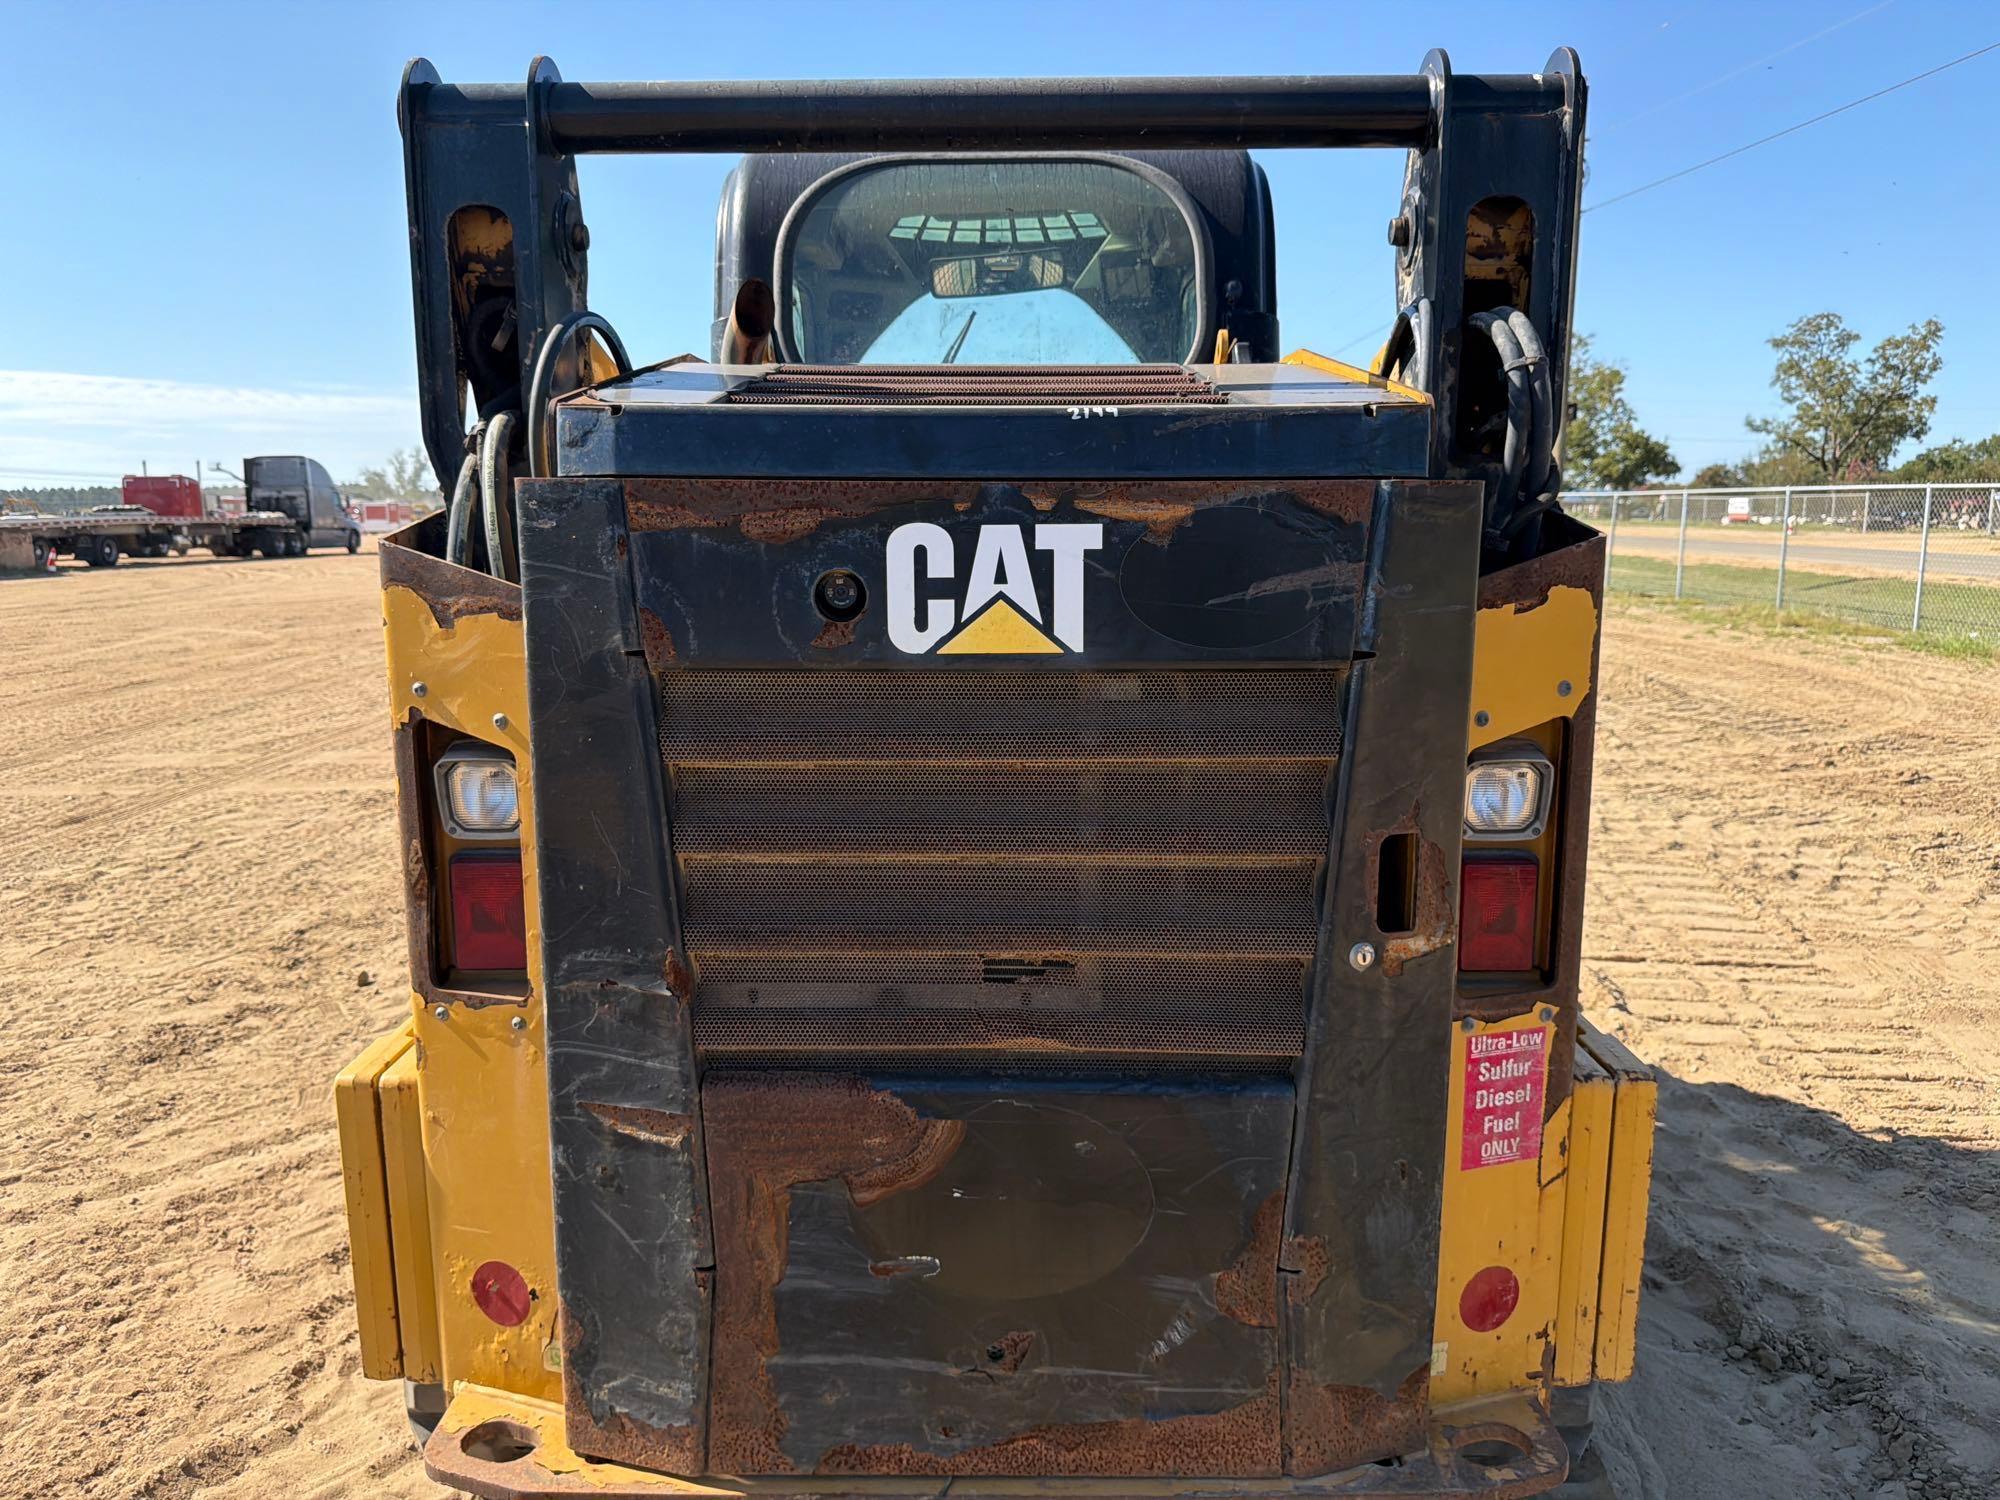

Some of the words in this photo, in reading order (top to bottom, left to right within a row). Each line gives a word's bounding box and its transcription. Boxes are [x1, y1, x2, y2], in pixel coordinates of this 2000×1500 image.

[886, 522, 1103, 654] CAT
[1471, 1031, 1543, 1054] Ultra-Low
[1478, 1058, 1533, 1082] Sulfur
[1475, 1083, 1531, 1110] Diesel
[1483, 1111, 1520, 1135] Fuel
[1481, 1137, 1521, 1158] ONLY
